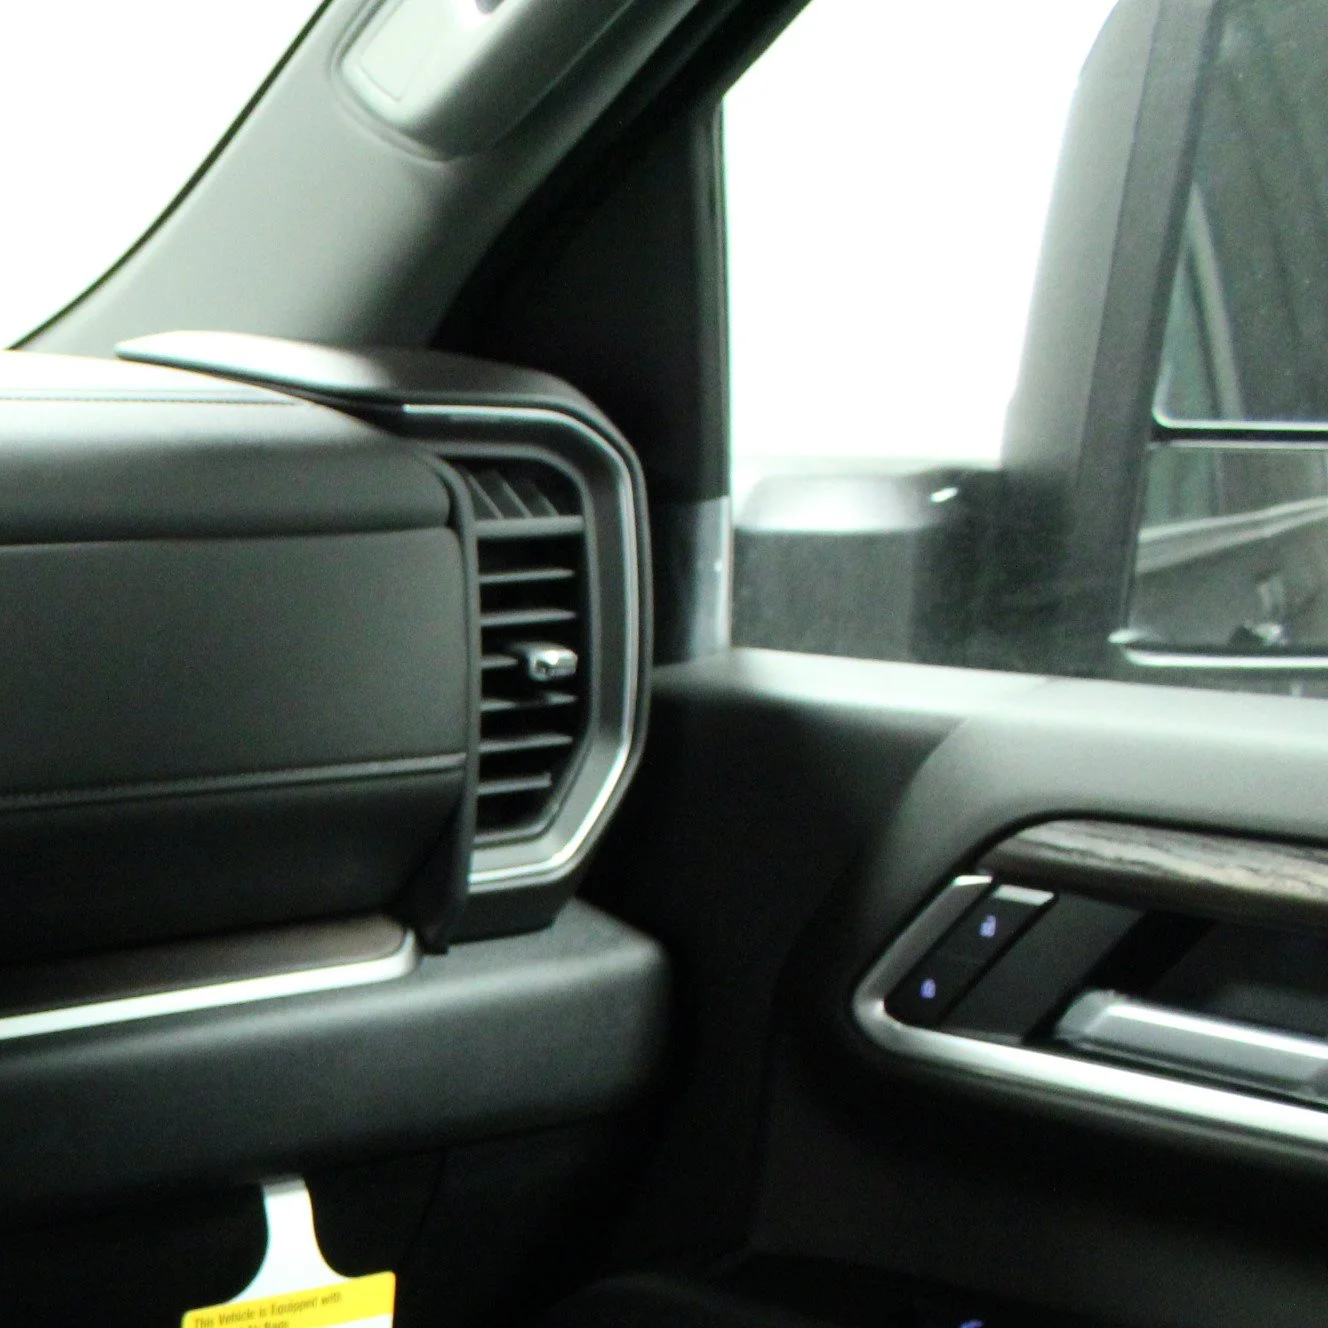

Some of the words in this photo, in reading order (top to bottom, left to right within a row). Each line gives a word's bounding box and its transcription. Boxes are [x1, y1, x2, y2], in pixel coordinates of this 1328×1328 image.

[218, 1309, 256, 1326] Vehicle
[270, 1296, 318, 1317] Equipped
[320, 1291, 343, 1308] with
